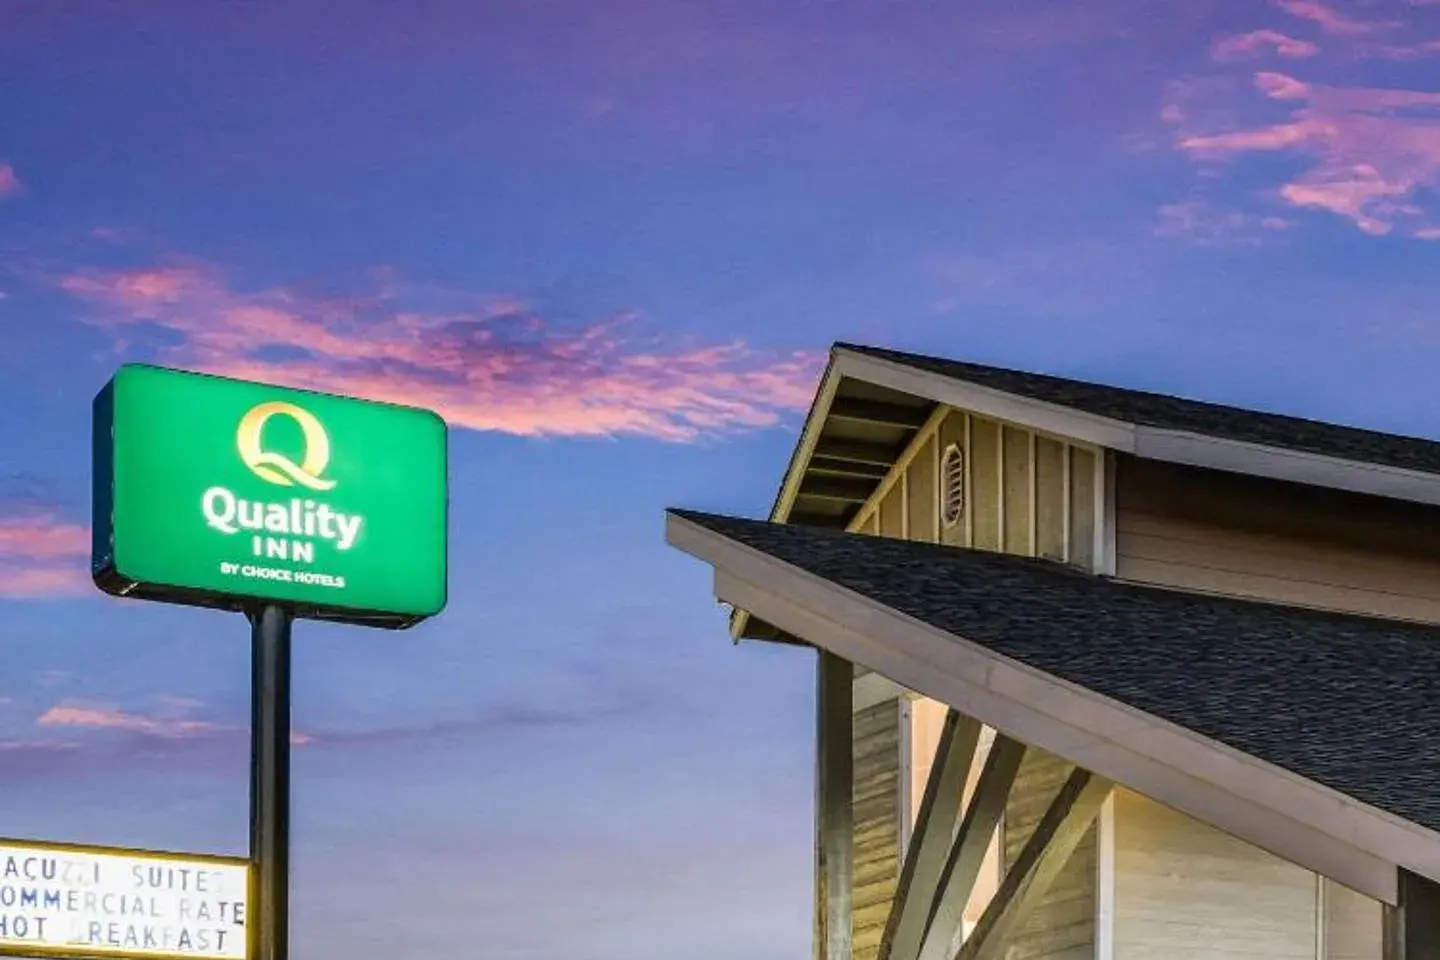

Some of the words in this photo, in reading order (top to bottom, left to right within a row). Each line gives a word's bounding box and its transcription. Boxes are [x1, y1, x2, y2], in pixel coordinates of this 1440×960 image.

[236, 401, 337, 491] Q
[202, 486, 362, 550] Quality
[253, 536, 314, 563] INN
[220, 561, 240, 575] BY
[242, 564, 292, 583] CHOICE
[293, 570, 346, 589] HOTELS
[180, 897, 245, 926] RATE
[71, 919, 227, 951] REAKFAST
